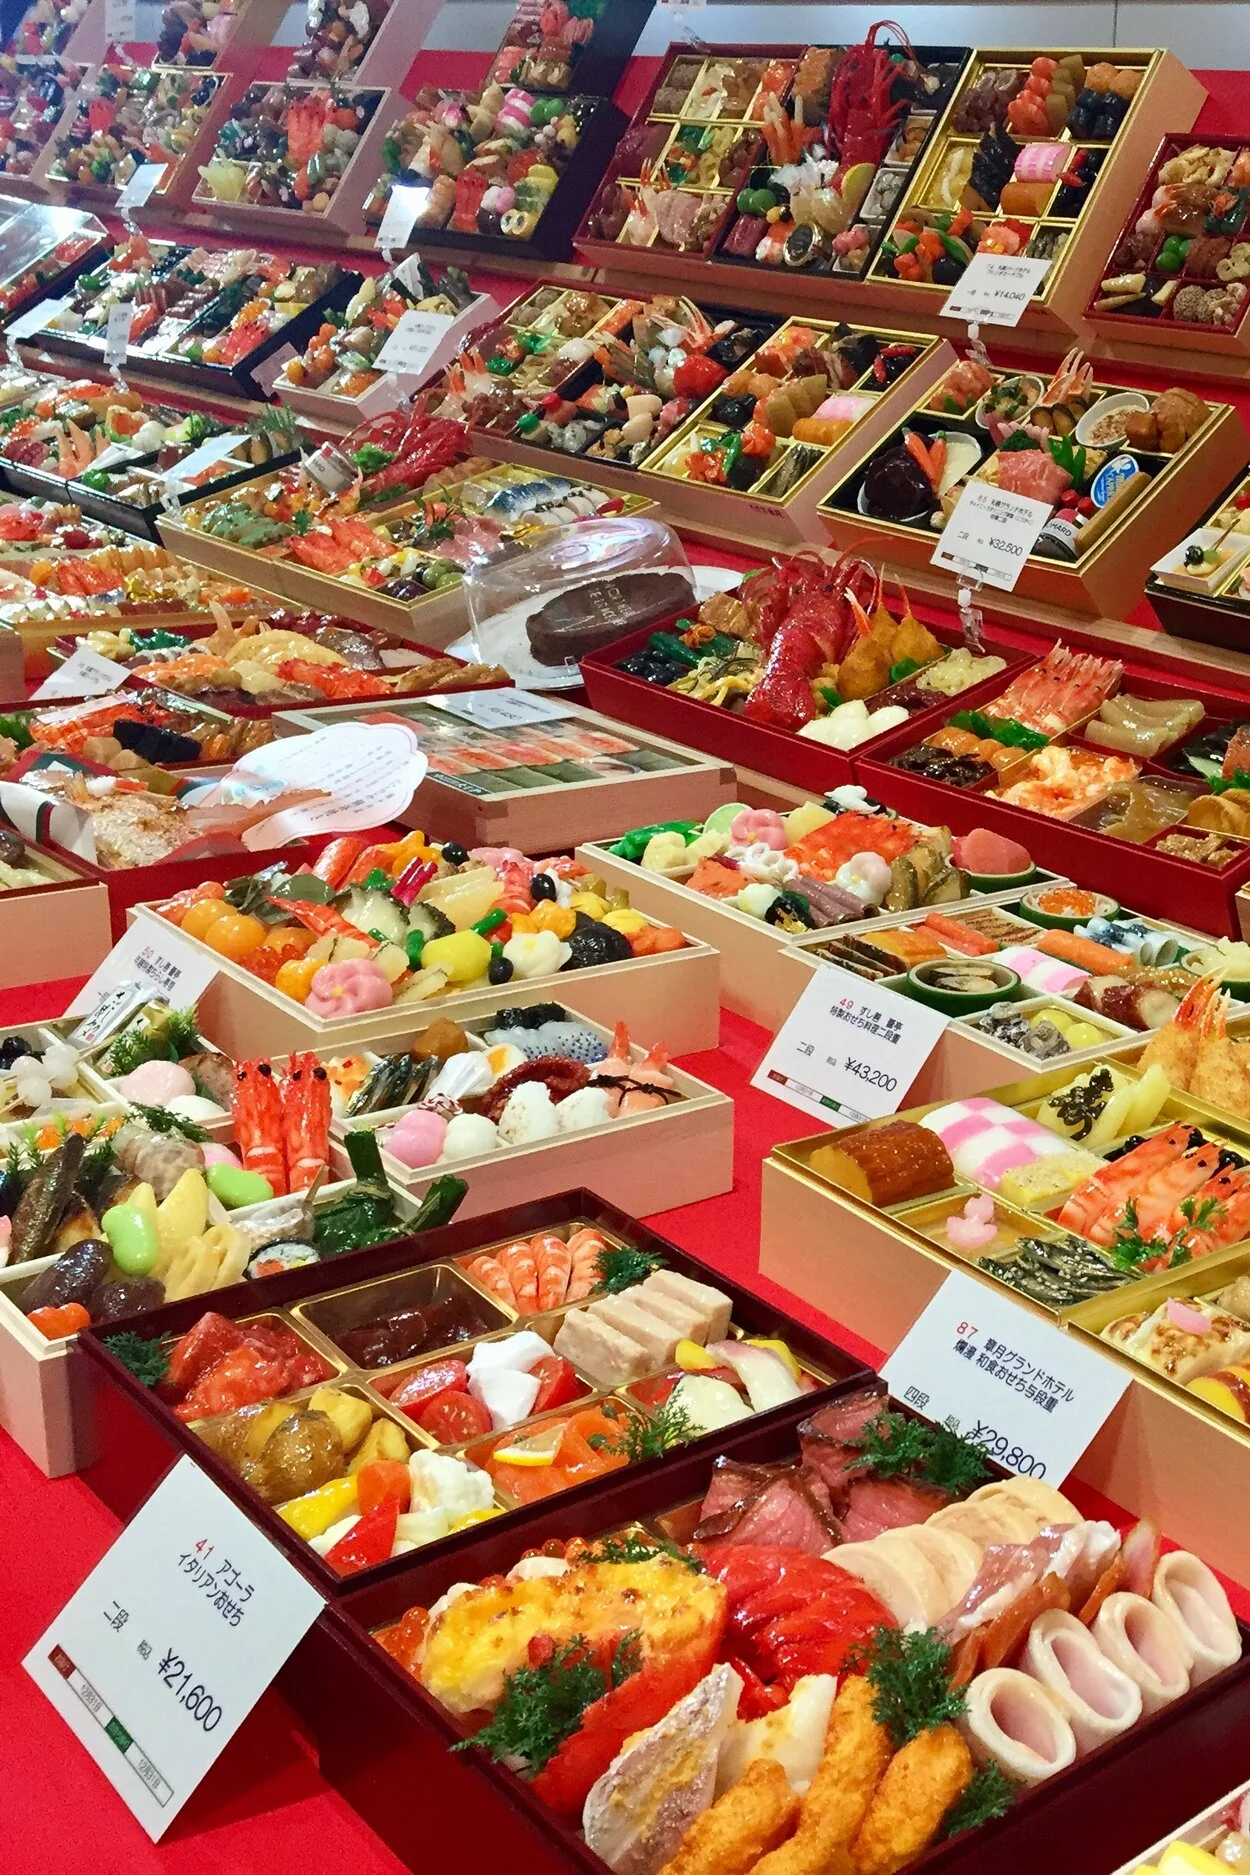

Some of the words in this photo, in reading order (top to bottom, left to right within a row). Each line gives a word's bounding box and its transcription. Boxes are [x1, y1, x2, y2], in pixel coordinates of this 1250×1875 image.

[988, 536, 1024, 557] ¥32,500
[829, 1004, 902, 1046] 特製おせち料理二段重
[838, 998, 855, 1010] 49
[858, 1005, 883, 1023] すし善
[796, 1041, 815, 1057] 二段
[843, 1056, 898, 1093] ¥43,200
[955, 1320, 980, 1341] 87
[982, 1337, 1075, 1404] 章月グランドホテル
[975, 1351, 1060, 1414] 和食おせち与段重
[903, 1384, 931, 1412] 四段
[968, 1419, 1047, 1480] ¥29,800
[177, 1551, 245, 1628] イタリアンおせち
[194, 1537, 216, 1561] 41
[215, 1558, 256, 1604] アゴーラ
[103, 1600, 130, 1633] 二段
[157, 1647, 224, 1733] ¥21,600
